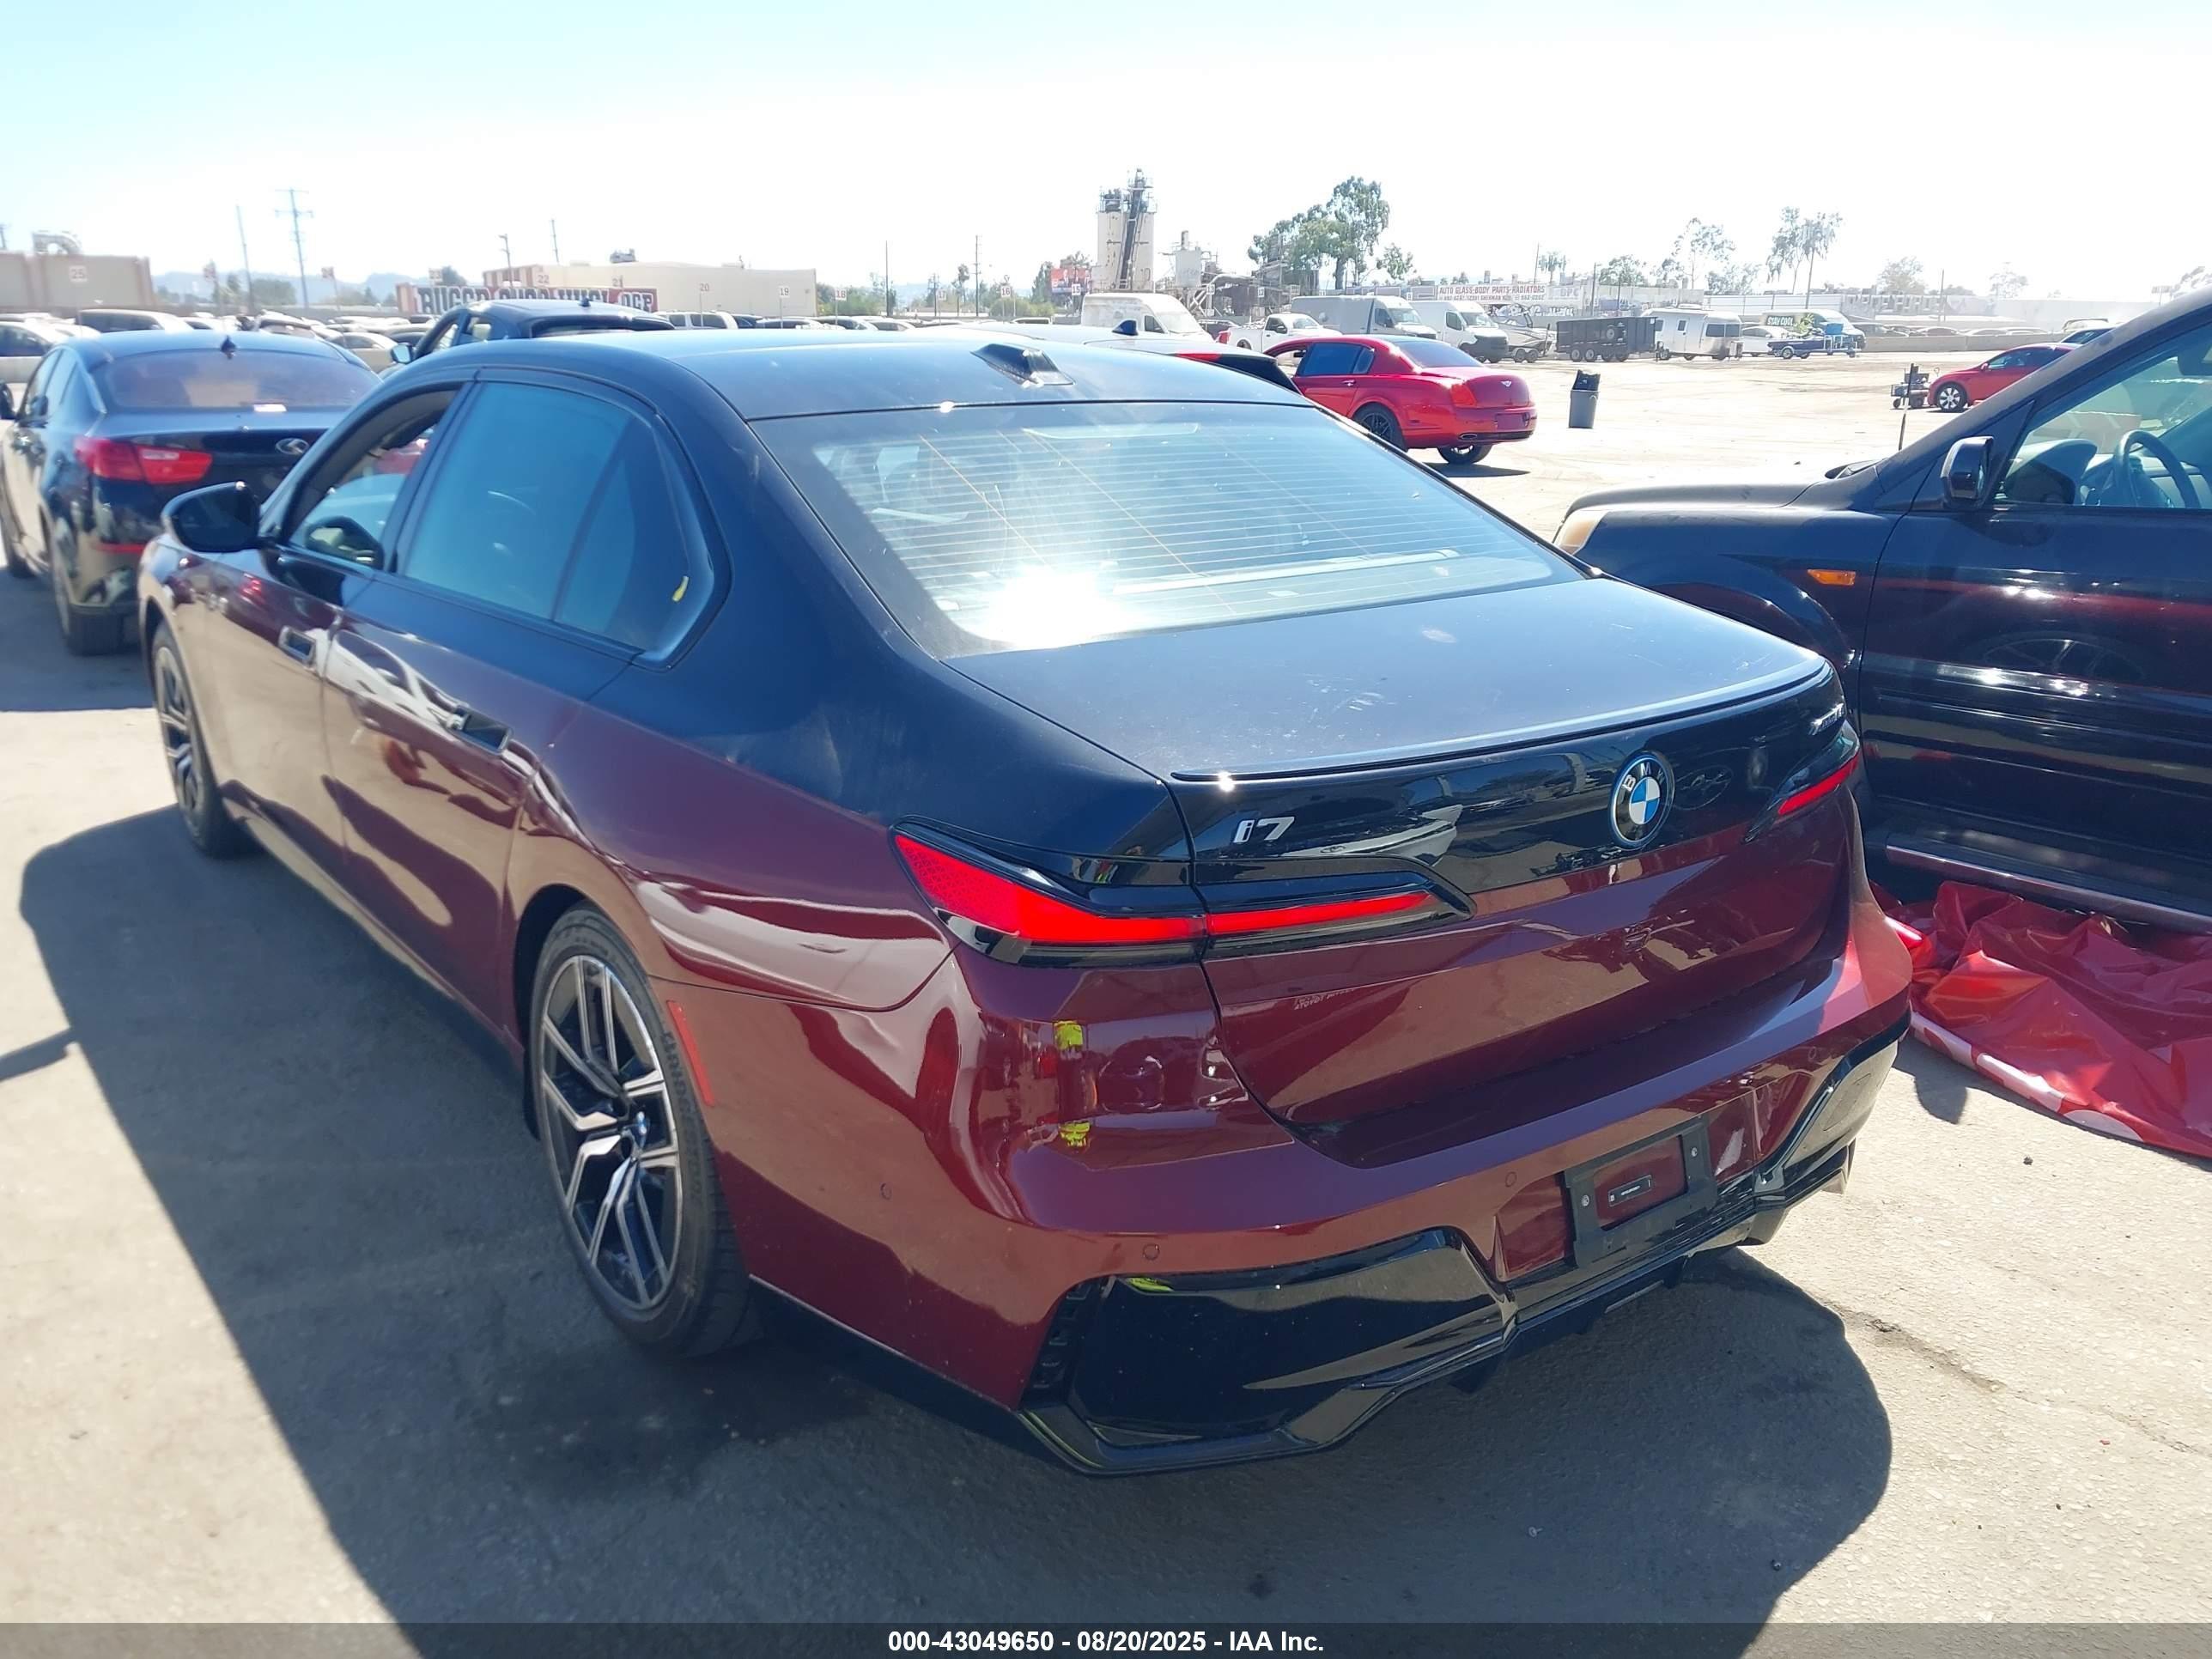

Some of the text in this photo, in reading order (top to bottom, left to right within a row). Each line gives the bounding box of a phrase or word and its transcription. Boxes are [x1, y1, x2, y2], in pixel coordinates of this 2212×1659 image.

[700, 283, 710, 292] 20
[780, 288, 789, 296] 19
[1002, 288, 1011, 296] 16
[1073, 285, 1080, 294] 15
[1492, 285, 1545, 294] PARTS-RADIATORS
[1767, 316, 1794, 326] STAY COOL
[1233, 816, 1295, 843] i7
